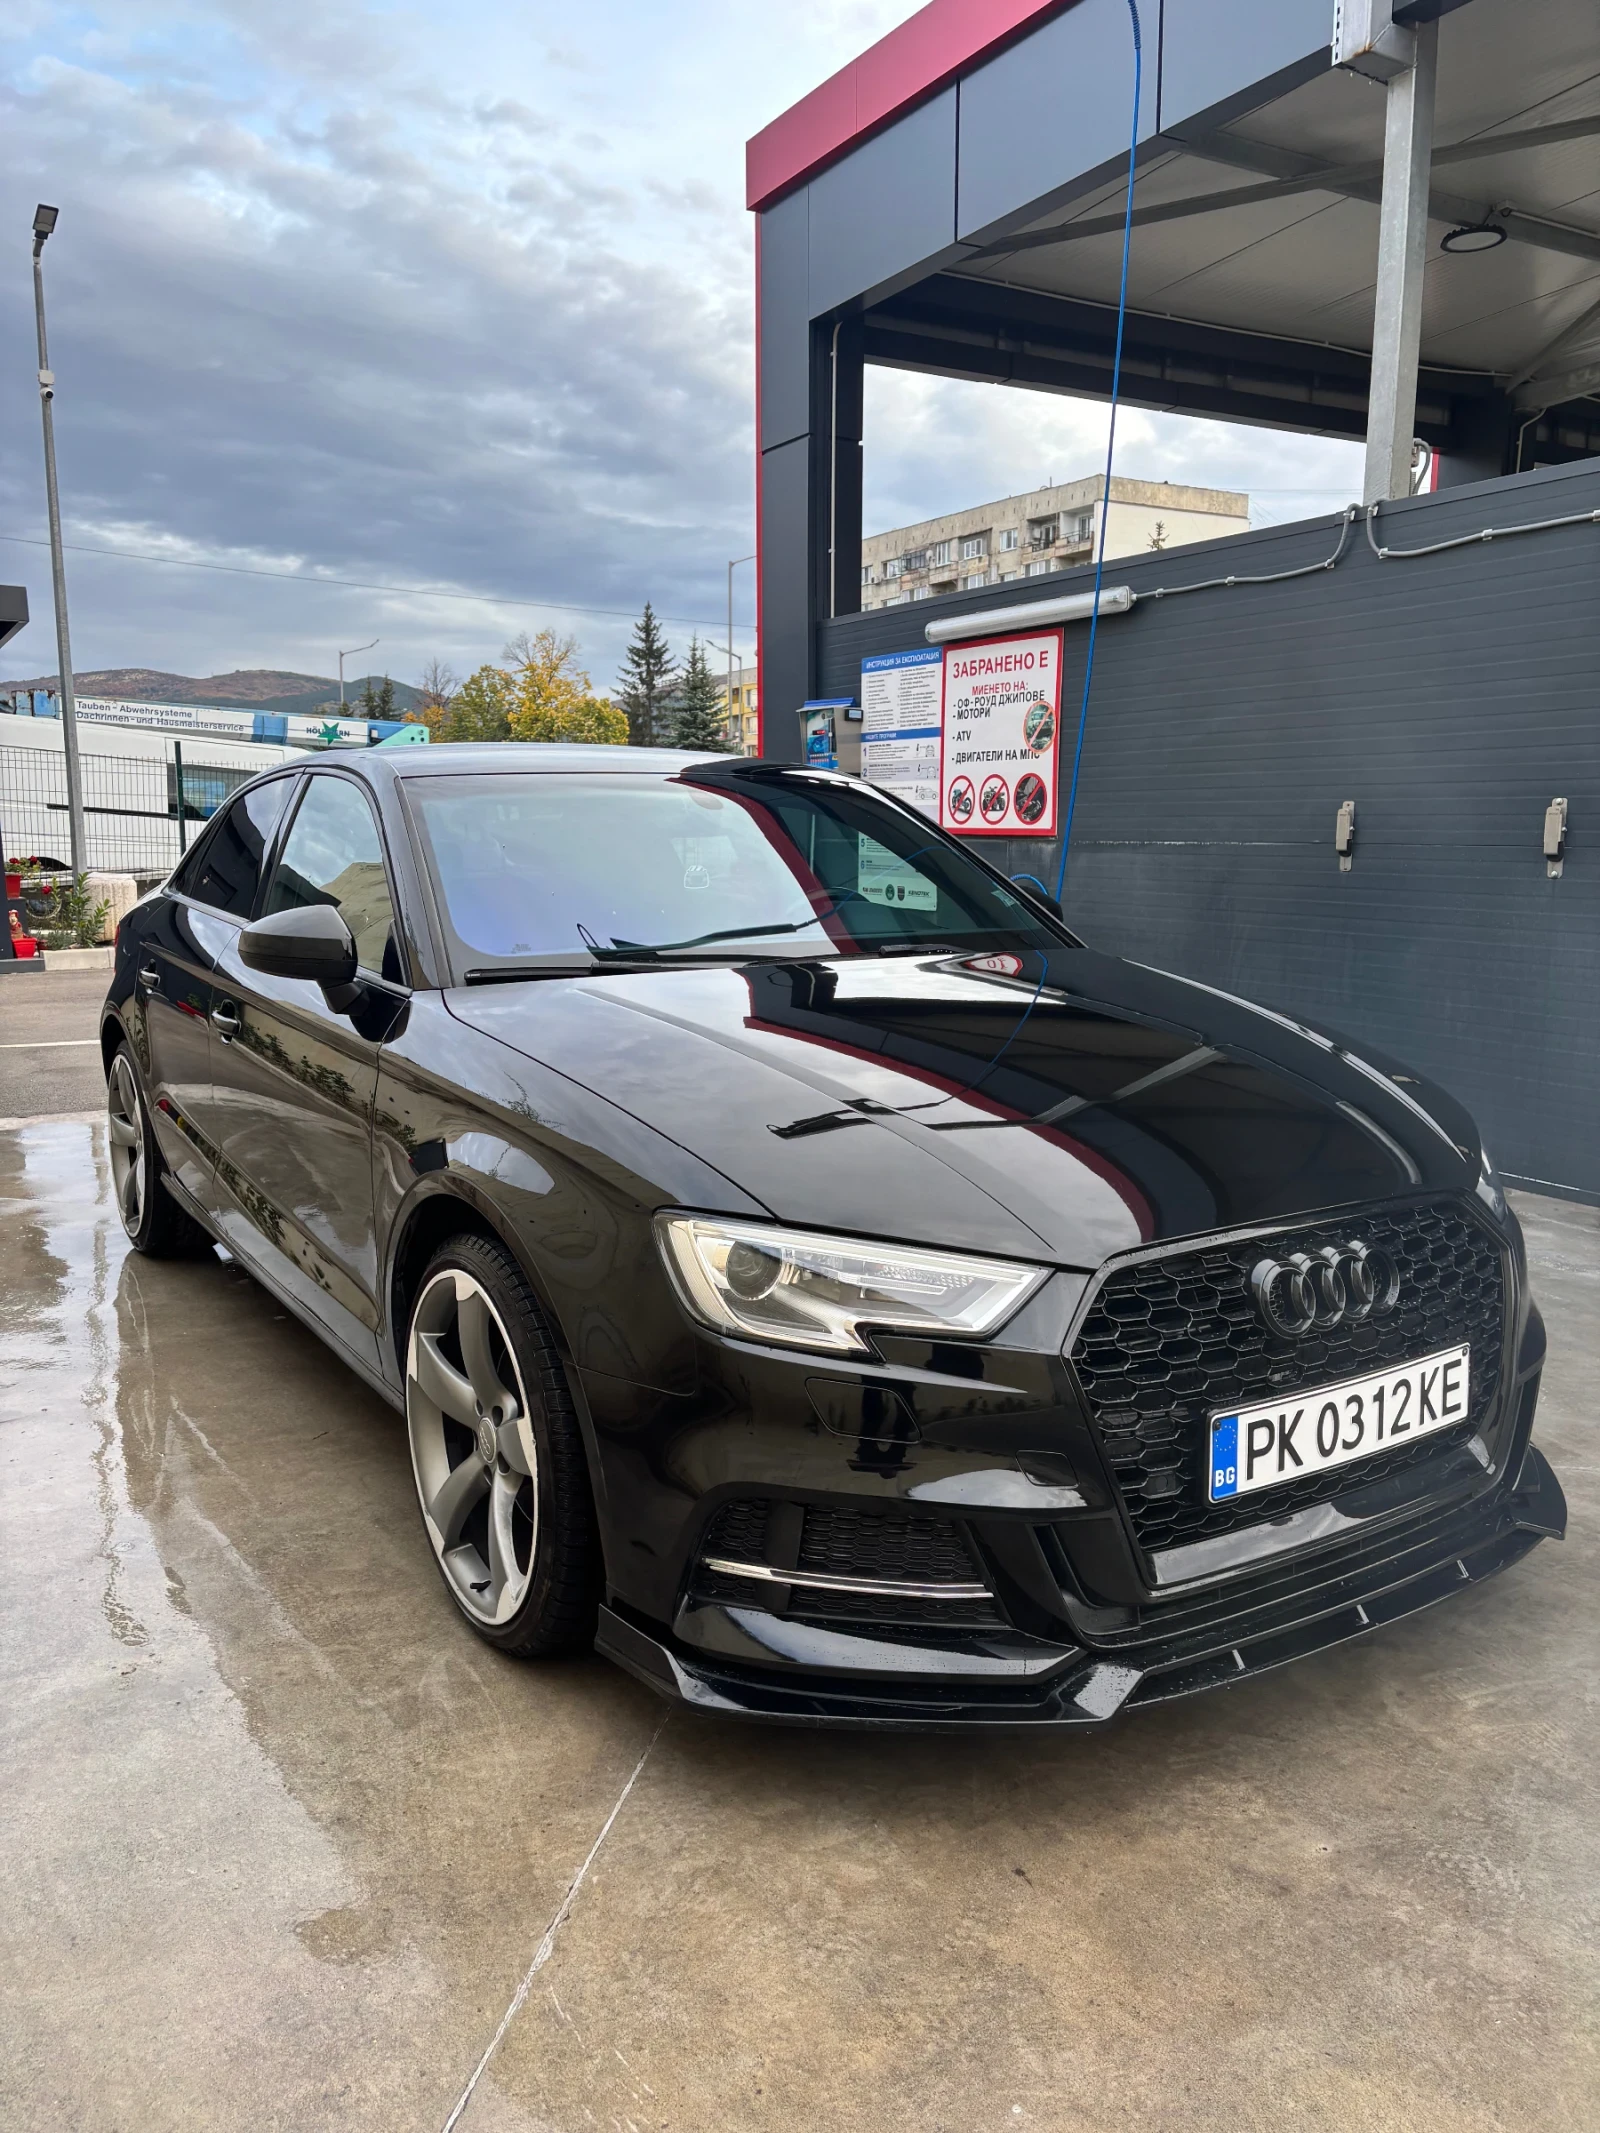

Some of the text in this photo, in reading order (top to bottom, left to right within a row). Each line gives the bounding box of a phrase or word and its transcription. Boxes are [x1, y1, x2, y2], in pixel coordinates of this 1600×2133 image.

[895, 657, 901, 665] ЗА
[953, 650, 1049, 679] ЗАБРАНЕНО Е
[971, 681, 1029, 696] МИЕНЕТО НА:
[998, 690, 1045, 706] ДЖИПОВЕ
[76, 700, 111, 711] Tauben
[119, 704, 193, 718] Abwehrsysteme
[156, 718, 244, 731] Hausmeisterservice
[1005, 749, 1018, 761] НА
[862, 768, 868, 777] 2
[861, 838, 865, 847] 5
[861, 860, 865, 869] 6
[1246, 1408, 1305, 1481] PK
[1214, 1466, 1235, 1488] BG
